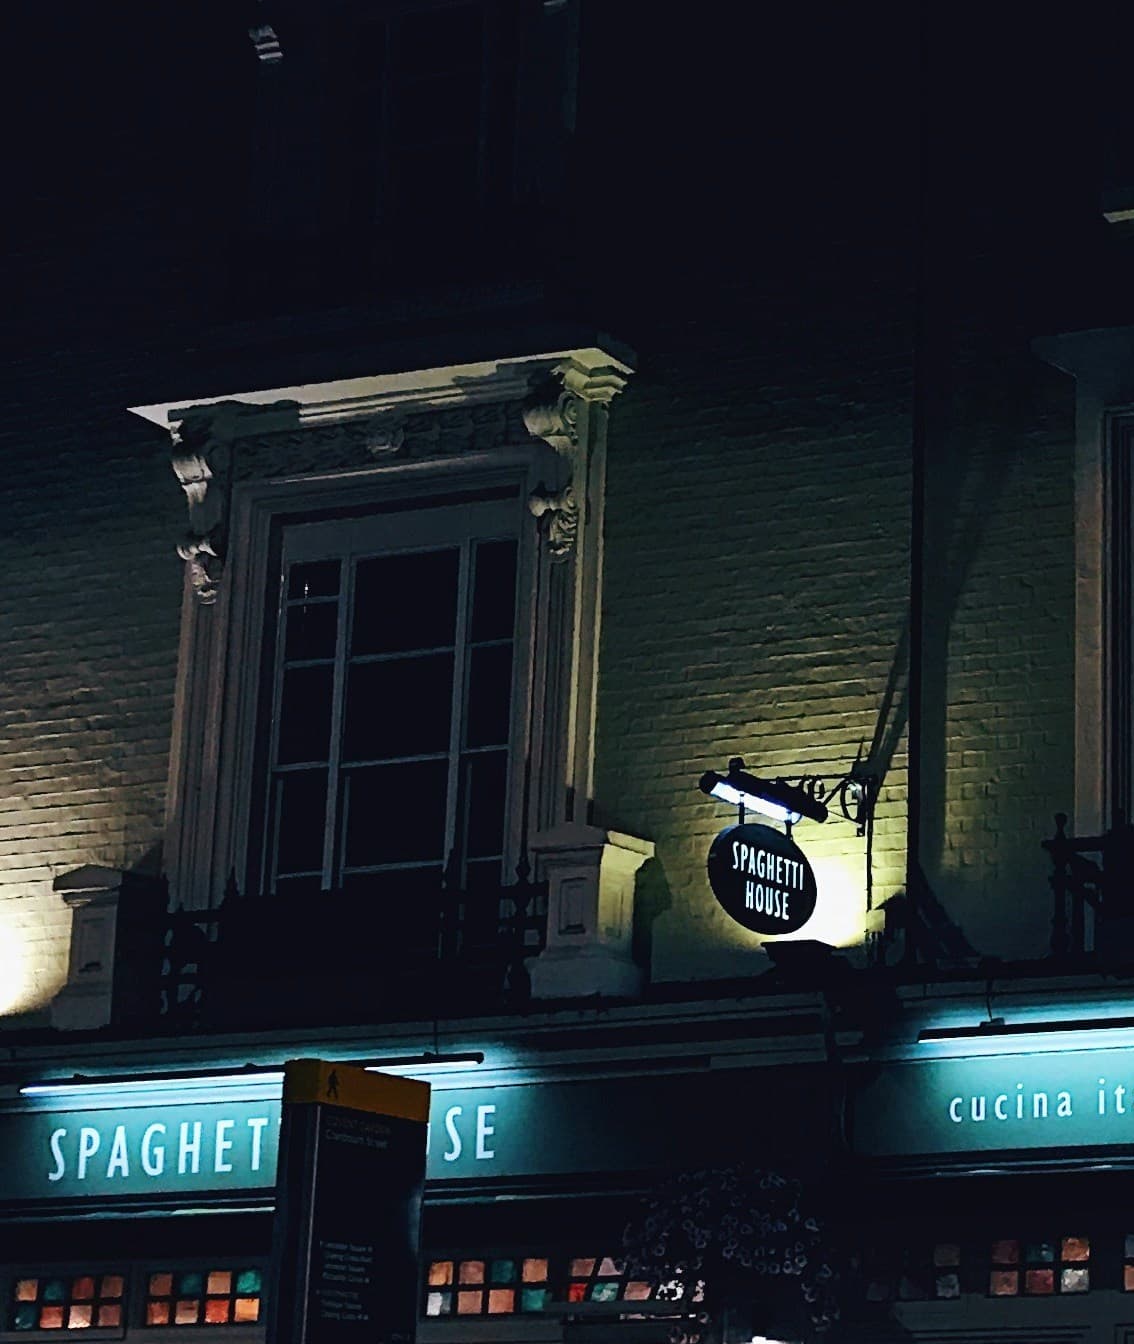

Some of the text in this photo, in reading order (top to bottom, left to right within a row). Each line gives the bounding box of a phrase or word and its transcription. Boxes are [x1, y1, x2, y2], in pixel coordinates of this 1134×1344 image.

[731, 840, 804, 891] SPAGHETTI
[744, 880, 790, 921] HOUSE
[948, 1083, 1073, 1123] cucina
[48, 1117, 282, 1182] SPAGHET
